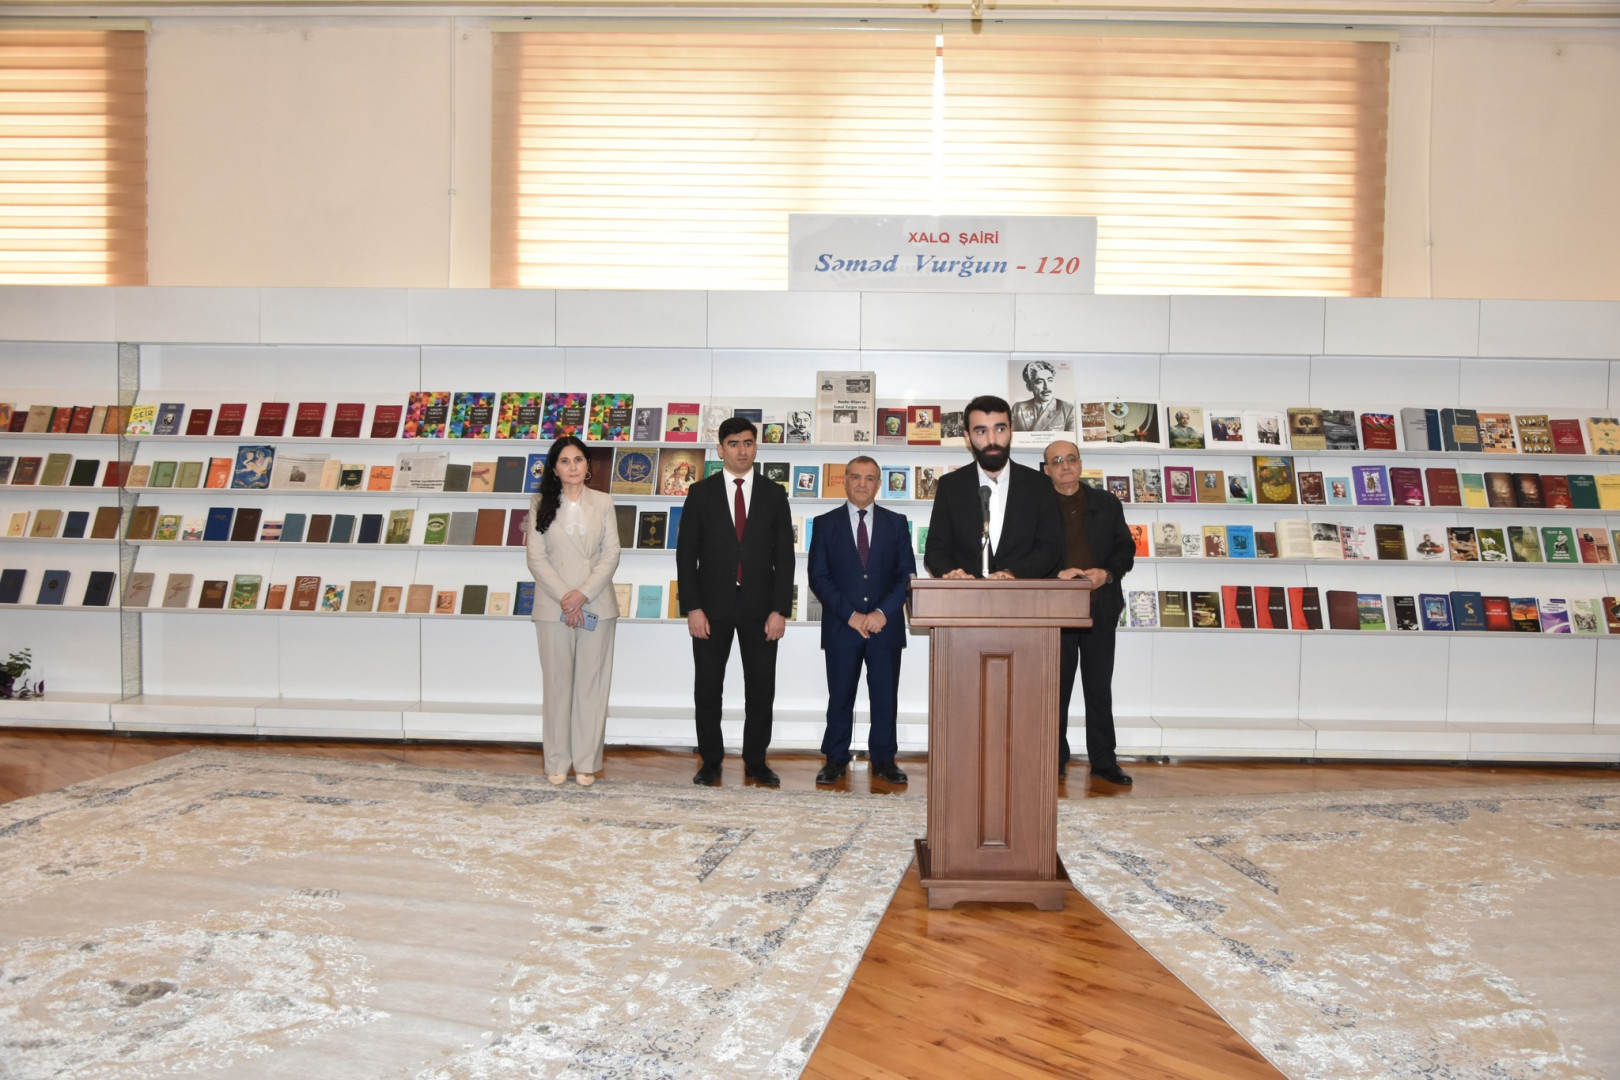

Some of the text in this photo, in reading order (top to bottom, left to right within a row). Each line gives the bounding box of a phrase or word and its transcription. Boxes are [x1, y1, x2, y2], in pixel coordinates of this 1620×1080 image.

[908, 230, 999, 246] XALQ ŞAİRİ
[815, 254, 899, 273] Səməd
[916, 254, 1007, 278] Vurğun
[1035, 256, 1080, 275] 120
